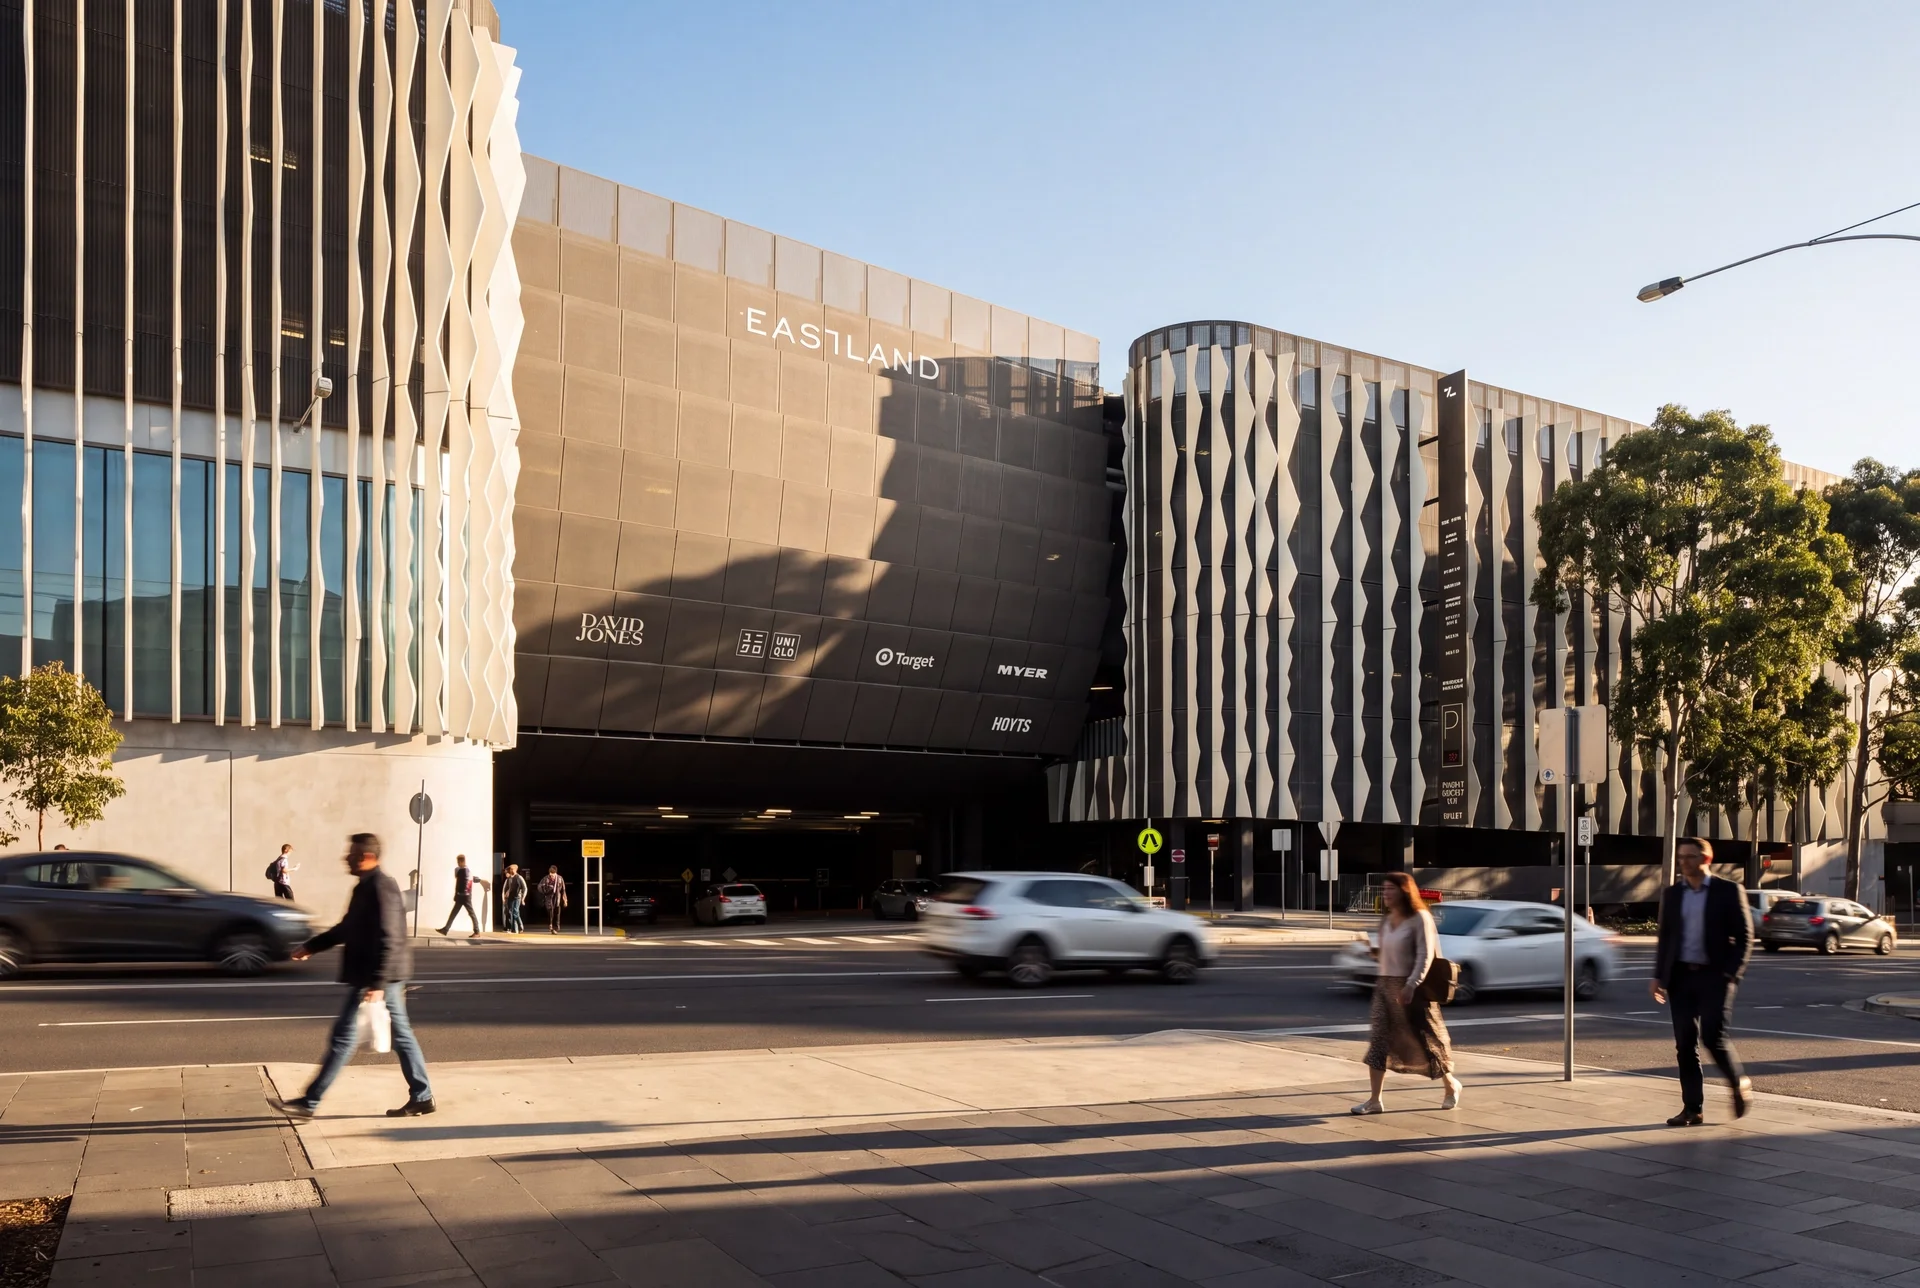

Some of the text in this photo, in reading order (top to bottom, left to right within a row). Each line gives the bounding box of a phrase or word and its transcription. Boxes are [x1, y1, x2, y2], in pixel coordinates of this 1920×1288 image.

[747, 307, 940, 380] EASTLAND
[581, 613, 644, 632] DAVID
[575, 627, 644, 645] JONES
[776, 636, 796, 647] UNI
[773, 646, 794, 657] QLO
[896, 652, 935, 670] Target
[997, 664, 1048, 679] MYER
[991, 716, 1032, 733] HOYTS
[1445, 710, 1459, 739] P
